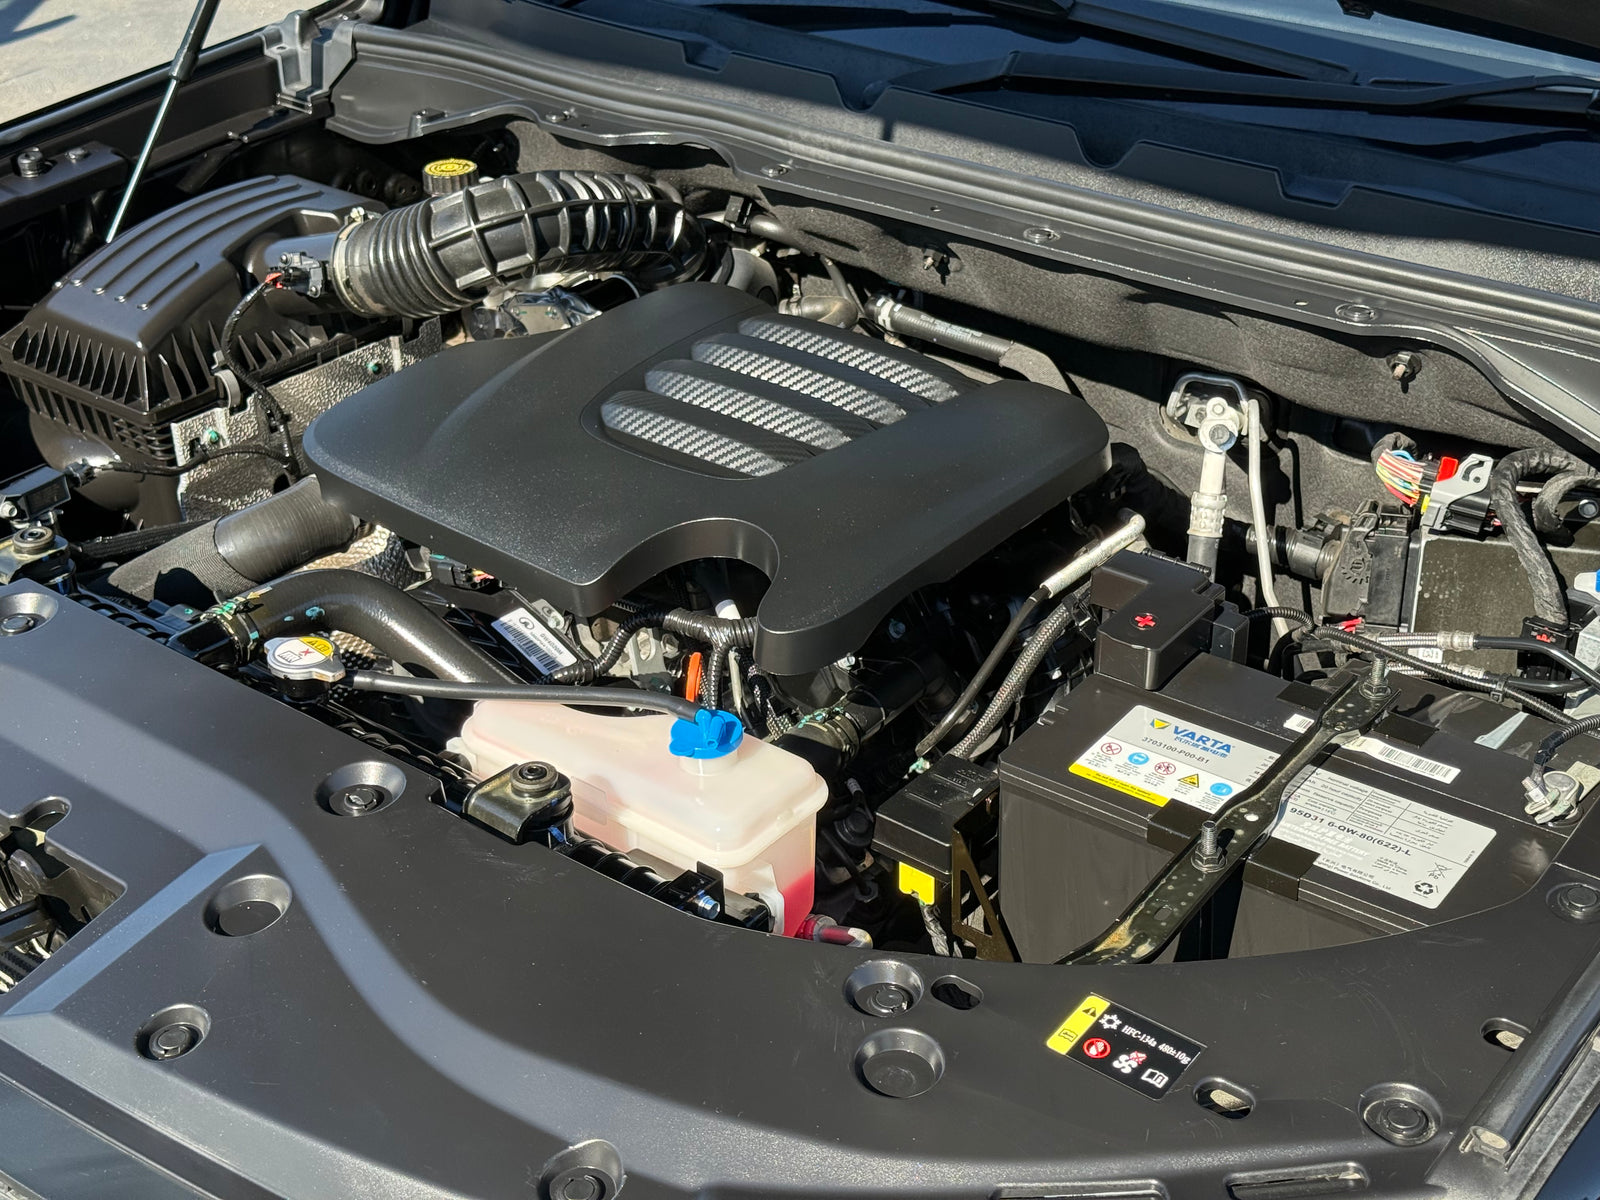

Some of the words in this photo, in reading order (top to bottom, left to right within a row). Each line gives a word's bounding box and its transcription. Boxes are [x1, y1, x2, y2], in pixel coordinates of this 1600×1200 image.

[1142, 736, 1210, 764] 3703100-P00-B1
[1173, 726, 1232, 754] VARTA
[1289, 806, 1324, 824] 95D31
[1328, 821, 1412, 856] 6-QW-80(622)-L
[1122, 1025, 1158, 1048] HFC-134a
[1158, 1043, 1192, 1065] 480±10g
